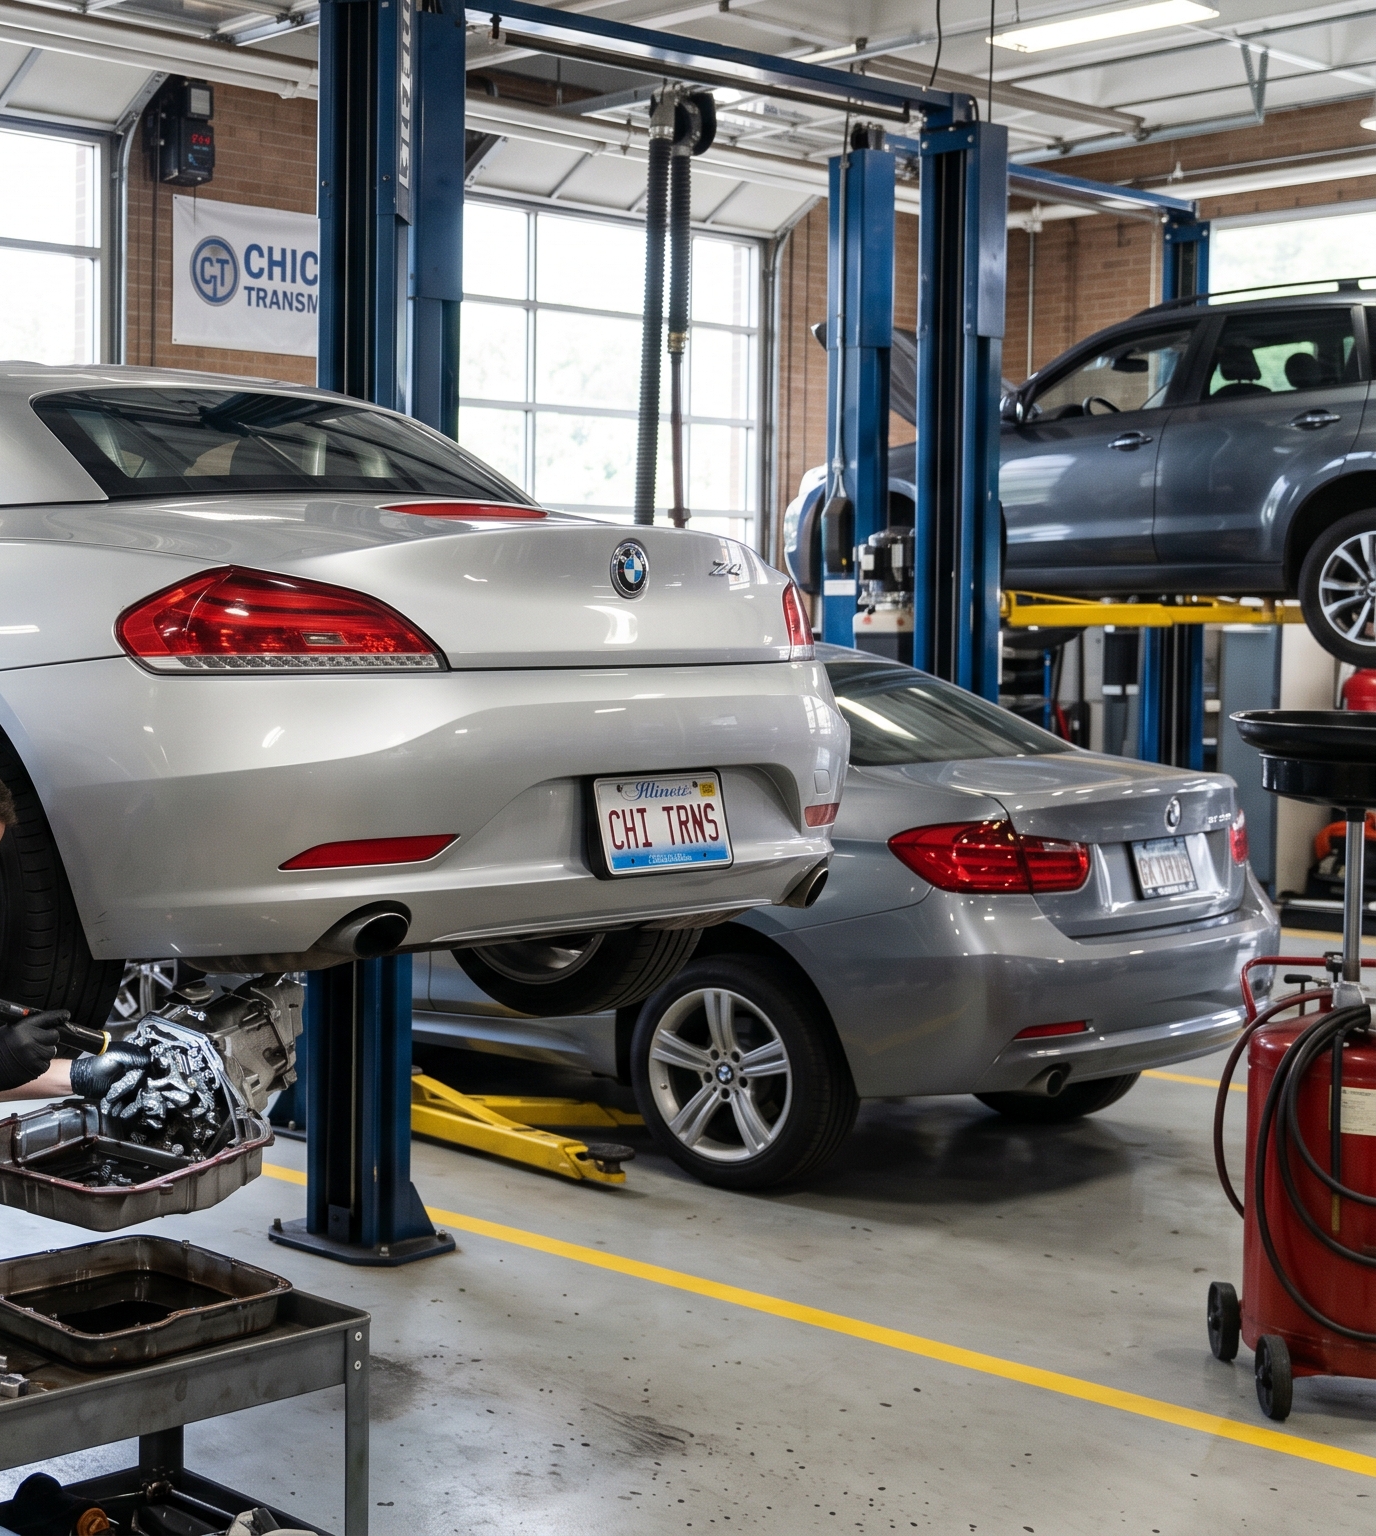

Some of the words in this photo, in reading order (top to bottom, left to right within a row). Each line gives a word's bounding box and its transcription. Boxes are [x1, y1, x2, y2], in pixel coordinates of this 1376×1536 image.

[243, 243, 318, 286] CHIC
[608, 807, 653, 850] CHI
[662, 802, 720, 846] TRNS
